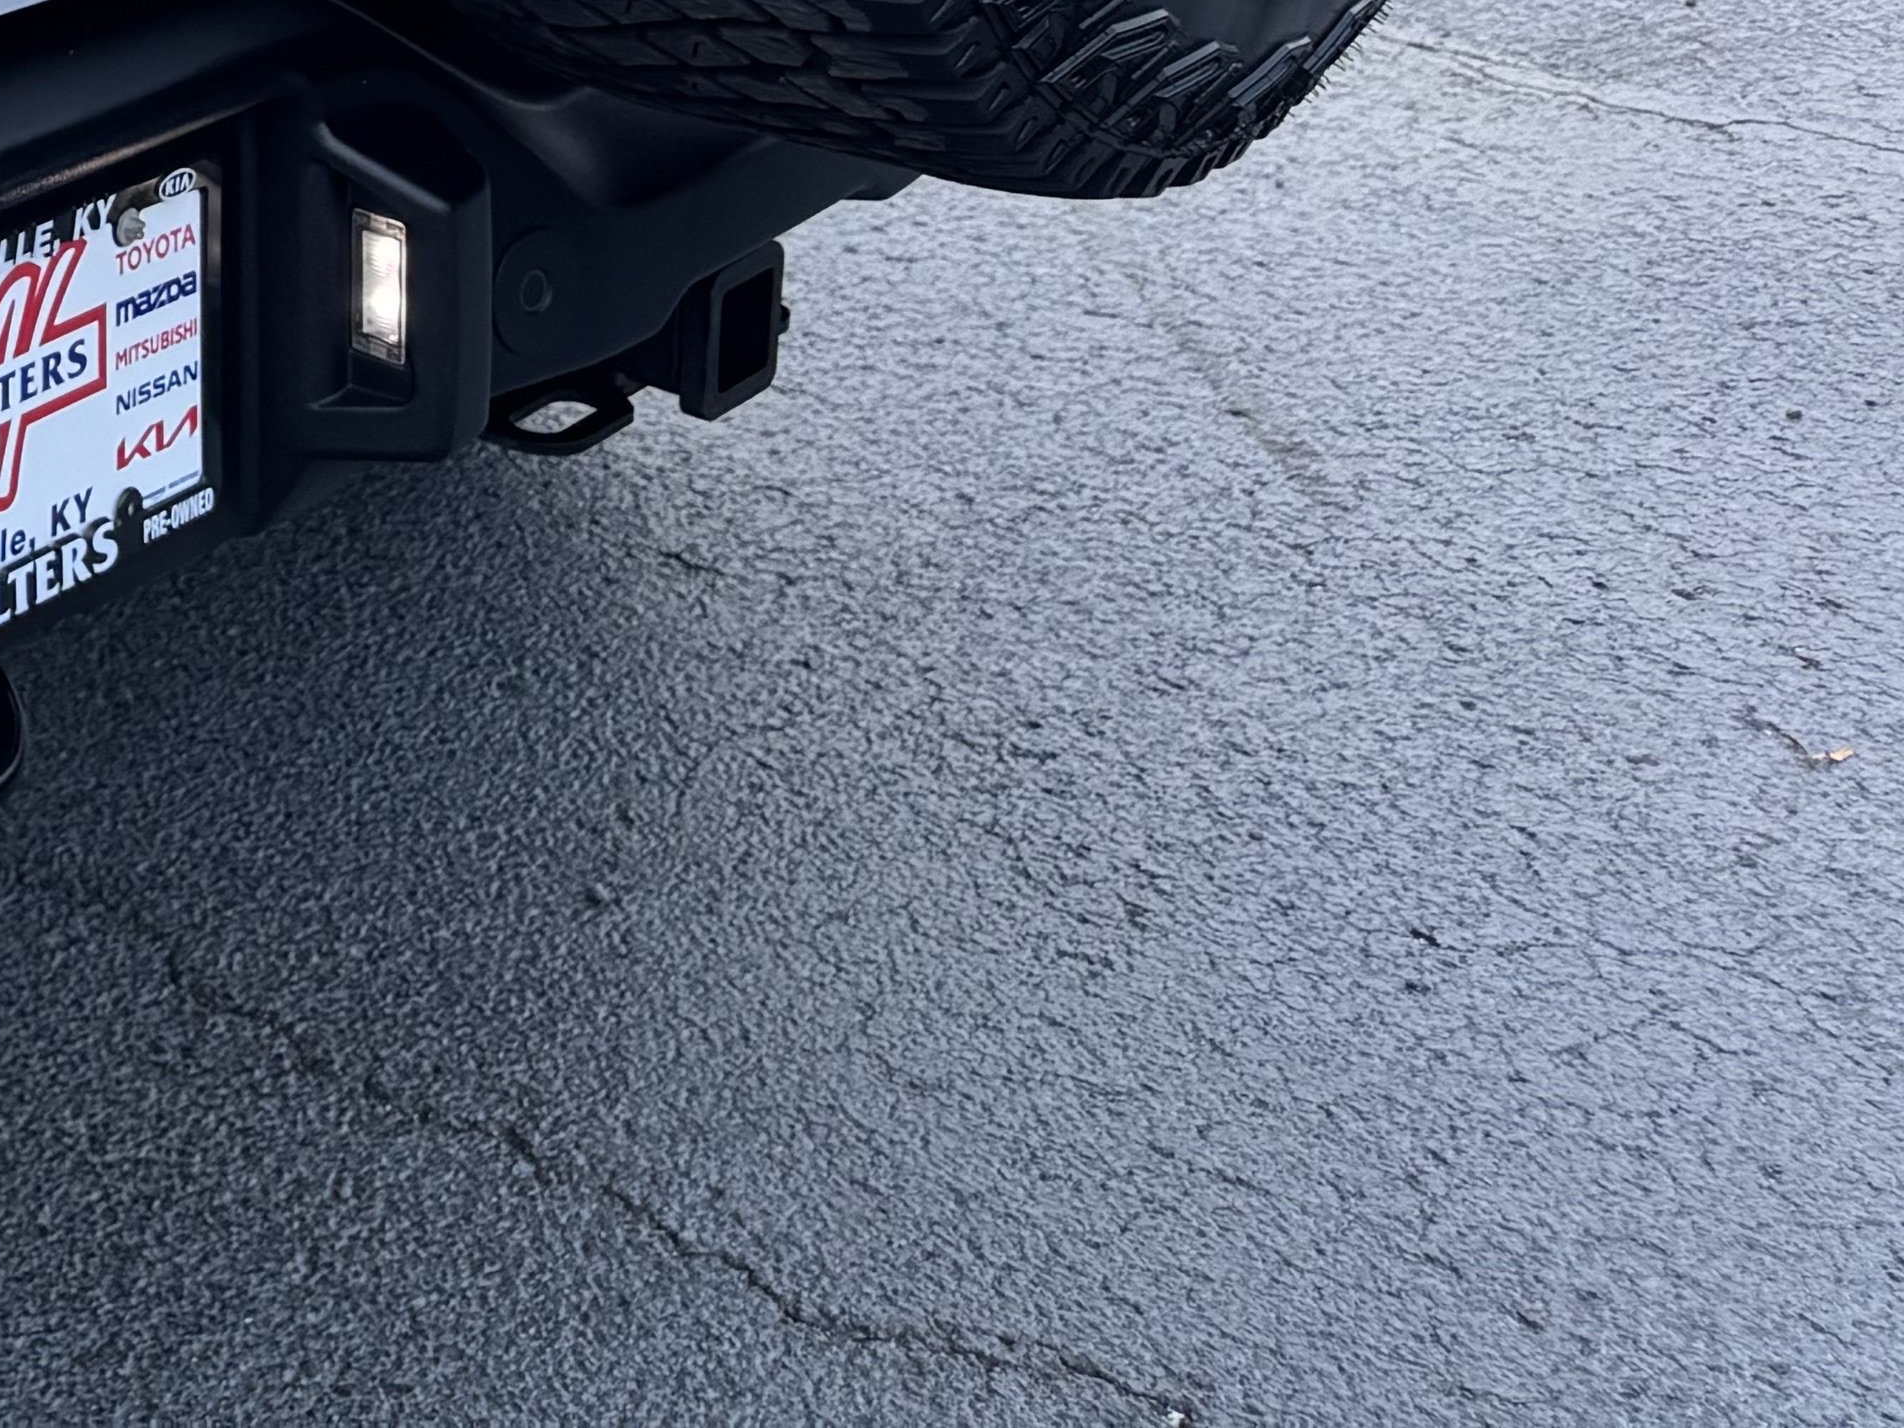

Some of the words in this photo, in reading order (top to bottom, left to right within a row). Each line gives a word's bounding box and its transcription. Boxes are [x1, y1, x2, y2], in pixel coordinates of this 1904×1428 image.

[164, 172, 193, 197] KIA
[73, 192, 118, 238] KY
[115, 223, 197, 276] TOYOTA
[115, 317, 198, 372] MITSUBISHI
[116, 365, 199, 415] NISSAN
[50, 486, 93, 539] KY
[143, 486, 215, 544] PRE-OWNED
